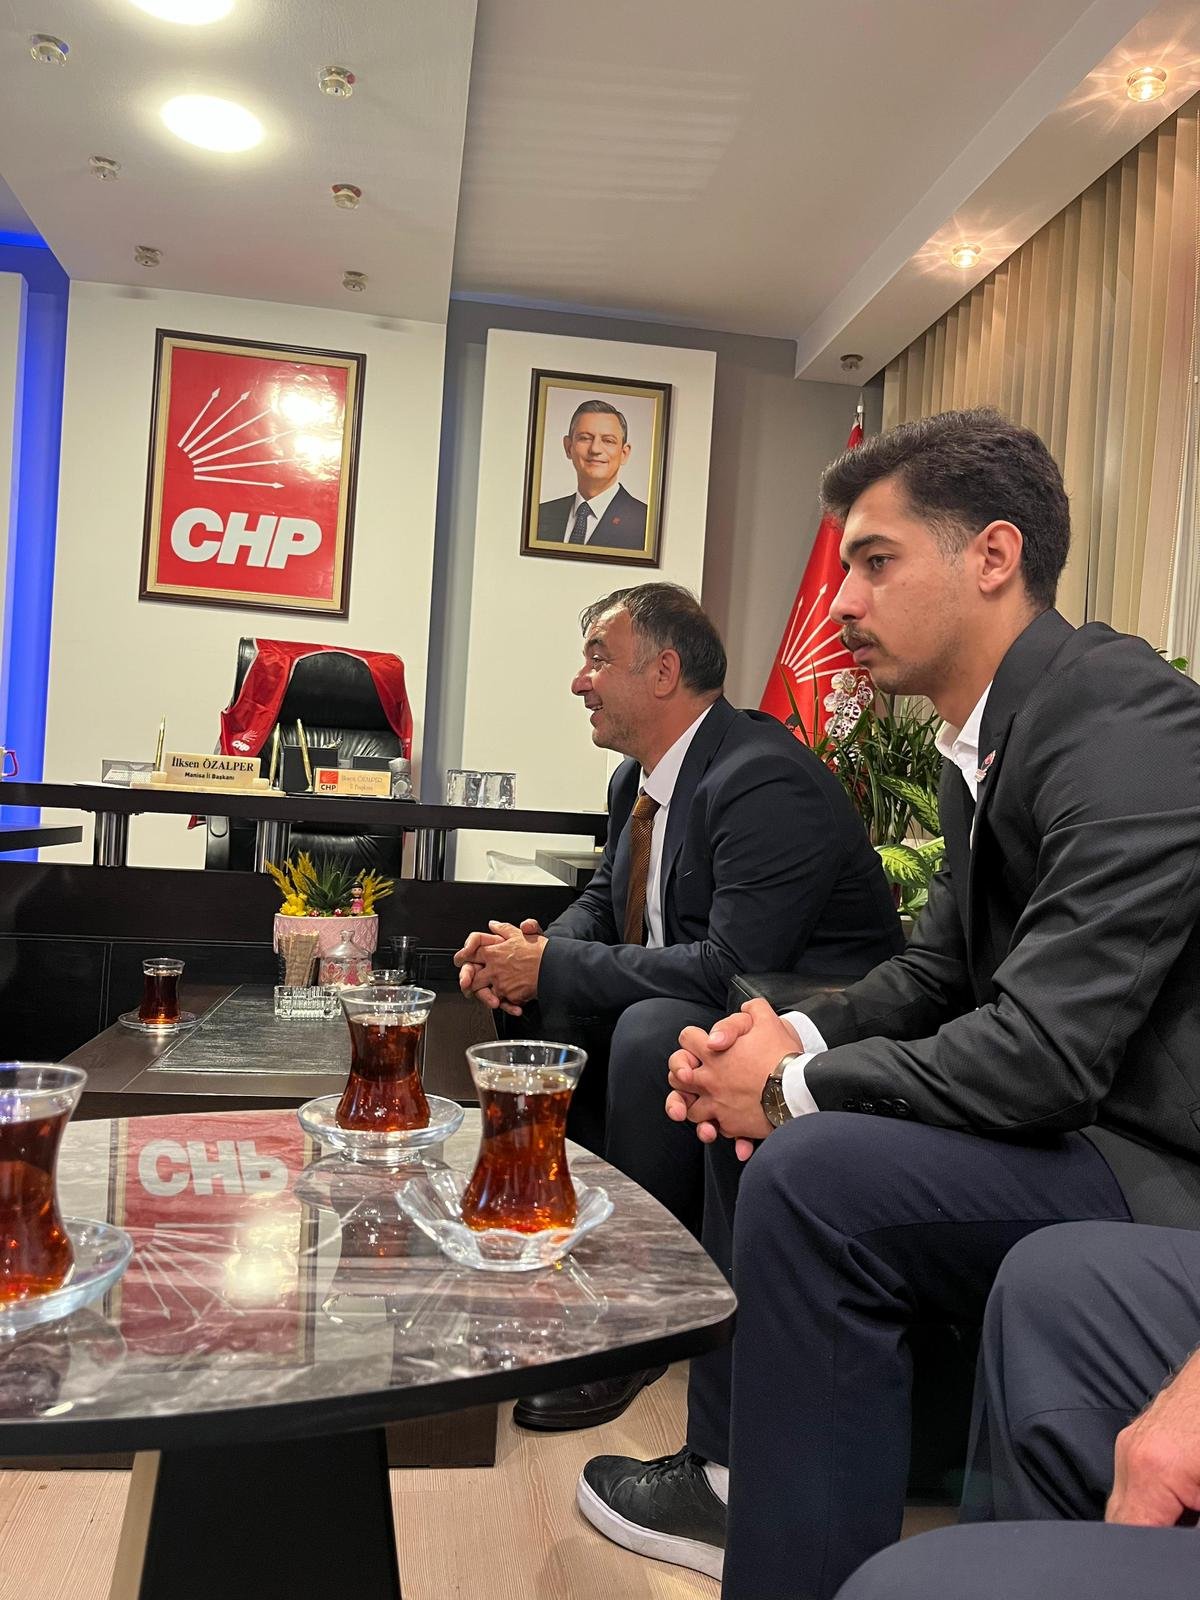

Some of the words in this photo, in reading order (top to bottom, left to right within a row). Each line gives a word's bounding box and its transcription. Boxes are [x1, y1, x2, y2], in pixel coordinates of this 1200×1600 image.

[170, 507, 322, 569] CHP
[171, 756, 200, 768] İlksen
[202, 758, 254, 772] ÖZALPER
[211, 773, 235, 781] Başkanı
